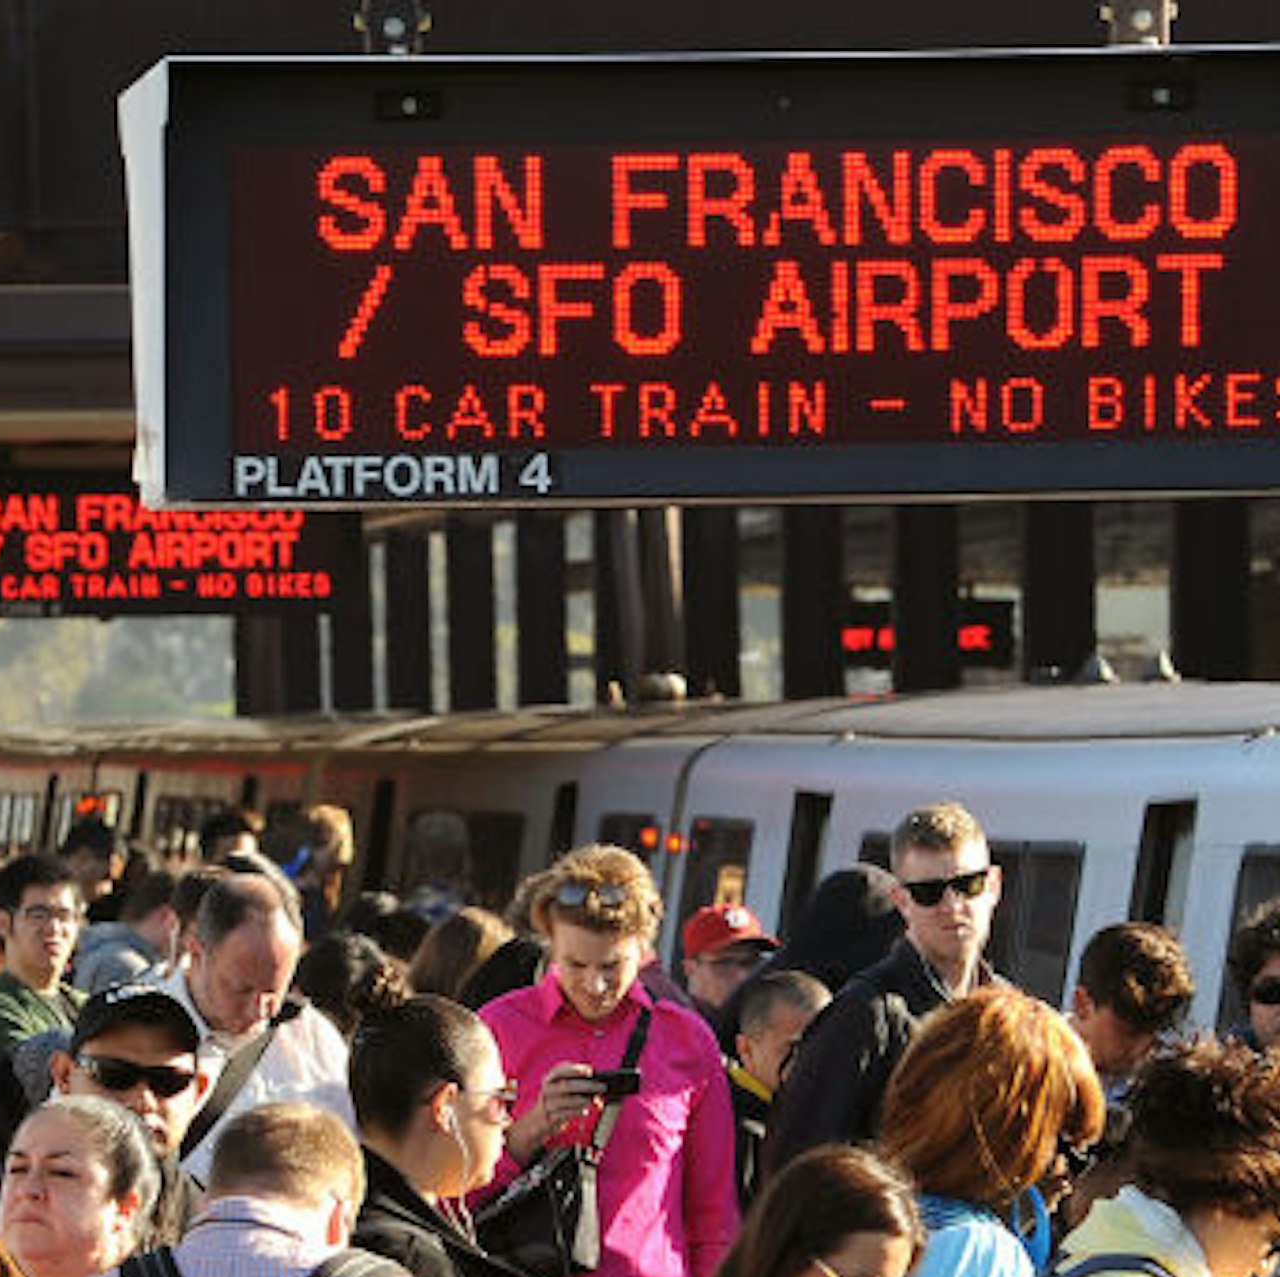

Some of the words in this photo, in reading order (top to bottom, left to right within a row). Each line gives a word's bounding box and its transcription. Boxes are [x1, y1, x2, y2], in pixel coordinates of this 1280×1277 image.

[316, 155, 544, 251] SAN
[612, 142, 1240, 248] FRANCISCO
[336, 264, 394, 359] /
[462, 260, 684, 358] SFO
[750, 252, 1226, 355] AIRPORT
[270, 384, 354, 442] 10
[394, 382, 548, 440] CAR
[589, 379, 828, 438] TRAIN
[949, 376, 1047, 433] NO
[233, 454, 500, 497] PLATFORM
[518, 451, 553, 494] 4
[24, 531, 109, 572] SFO
[128, 531, 300, 571] AIRPORT
[1, 574, 60, 601] CAR
[71, 573, 160, 599] TRAIN
[196, 572, 237, 598] NO
